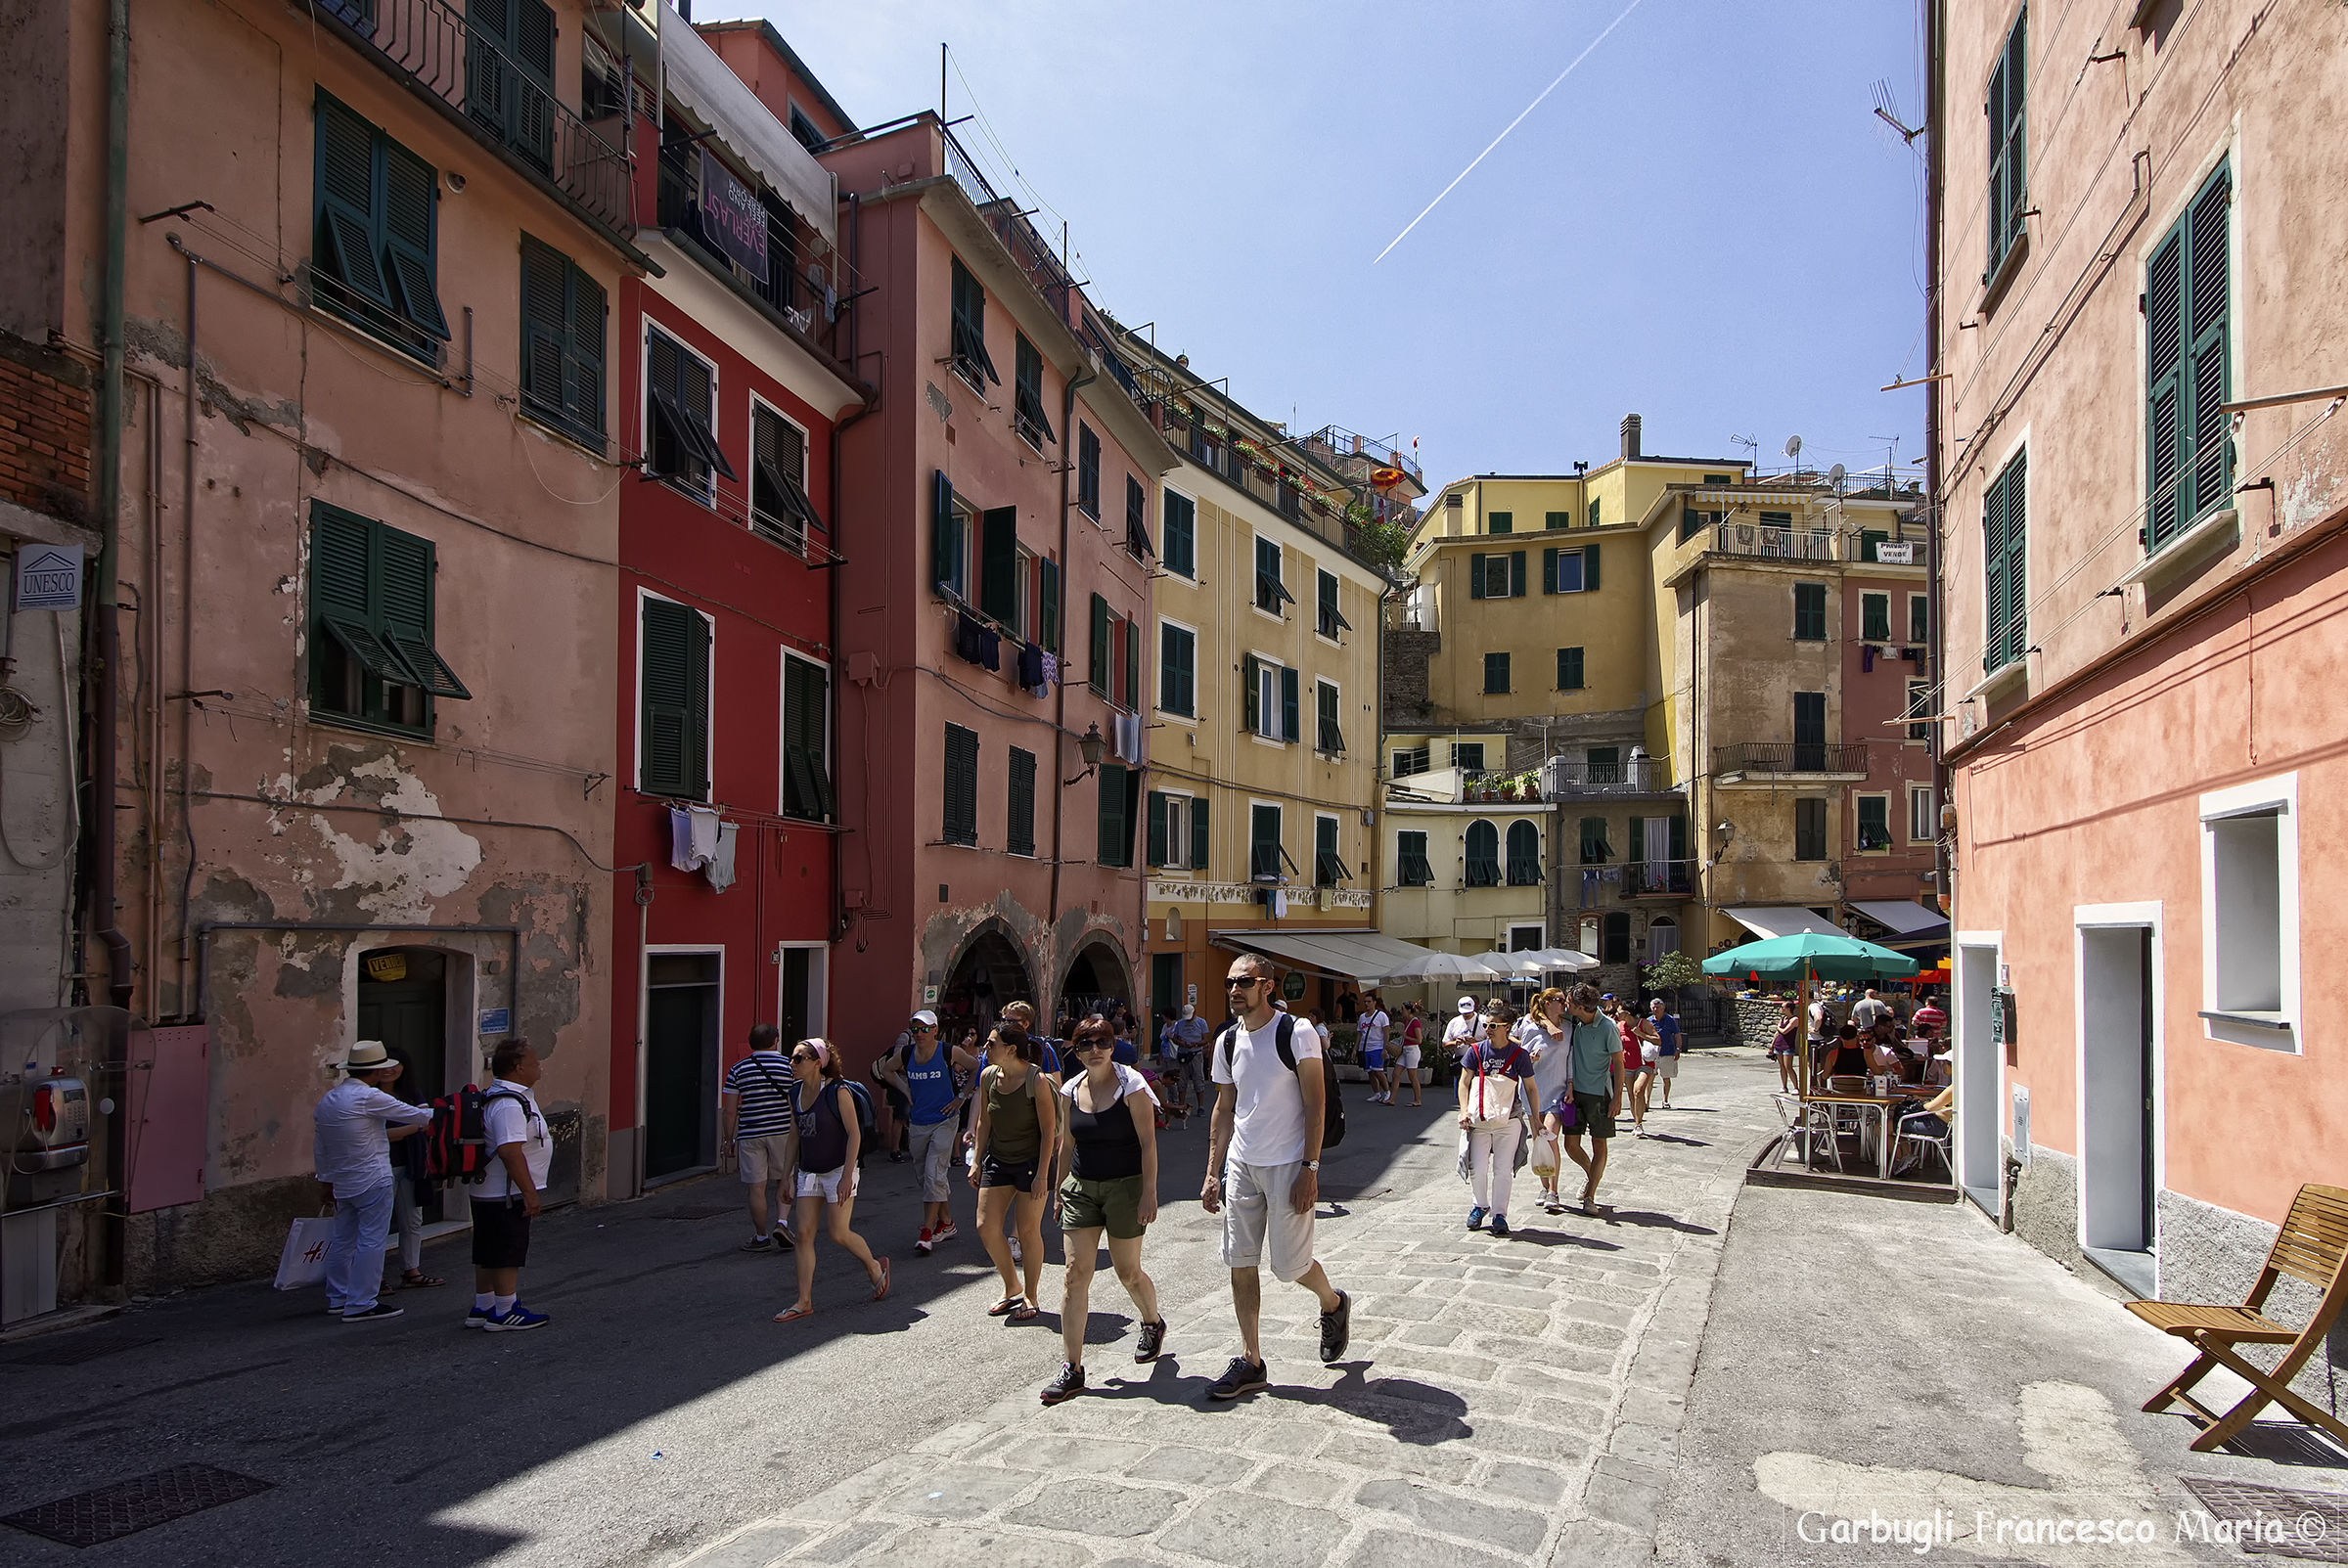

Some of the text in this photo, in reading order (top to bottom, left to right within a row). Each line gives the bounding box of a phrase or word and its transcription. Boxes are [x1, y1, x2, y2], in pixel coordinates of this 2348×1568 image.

[728, 179, 765, 218] PERFORM
[728, 190, 765, 227] FEEL AND
[703, 187, 765, 258] EVERLAST
[23, 573, 75, 594] UNESCO
[929, 1070, 941, 1079] 23
[302, 1240, 332, 1264] H&
